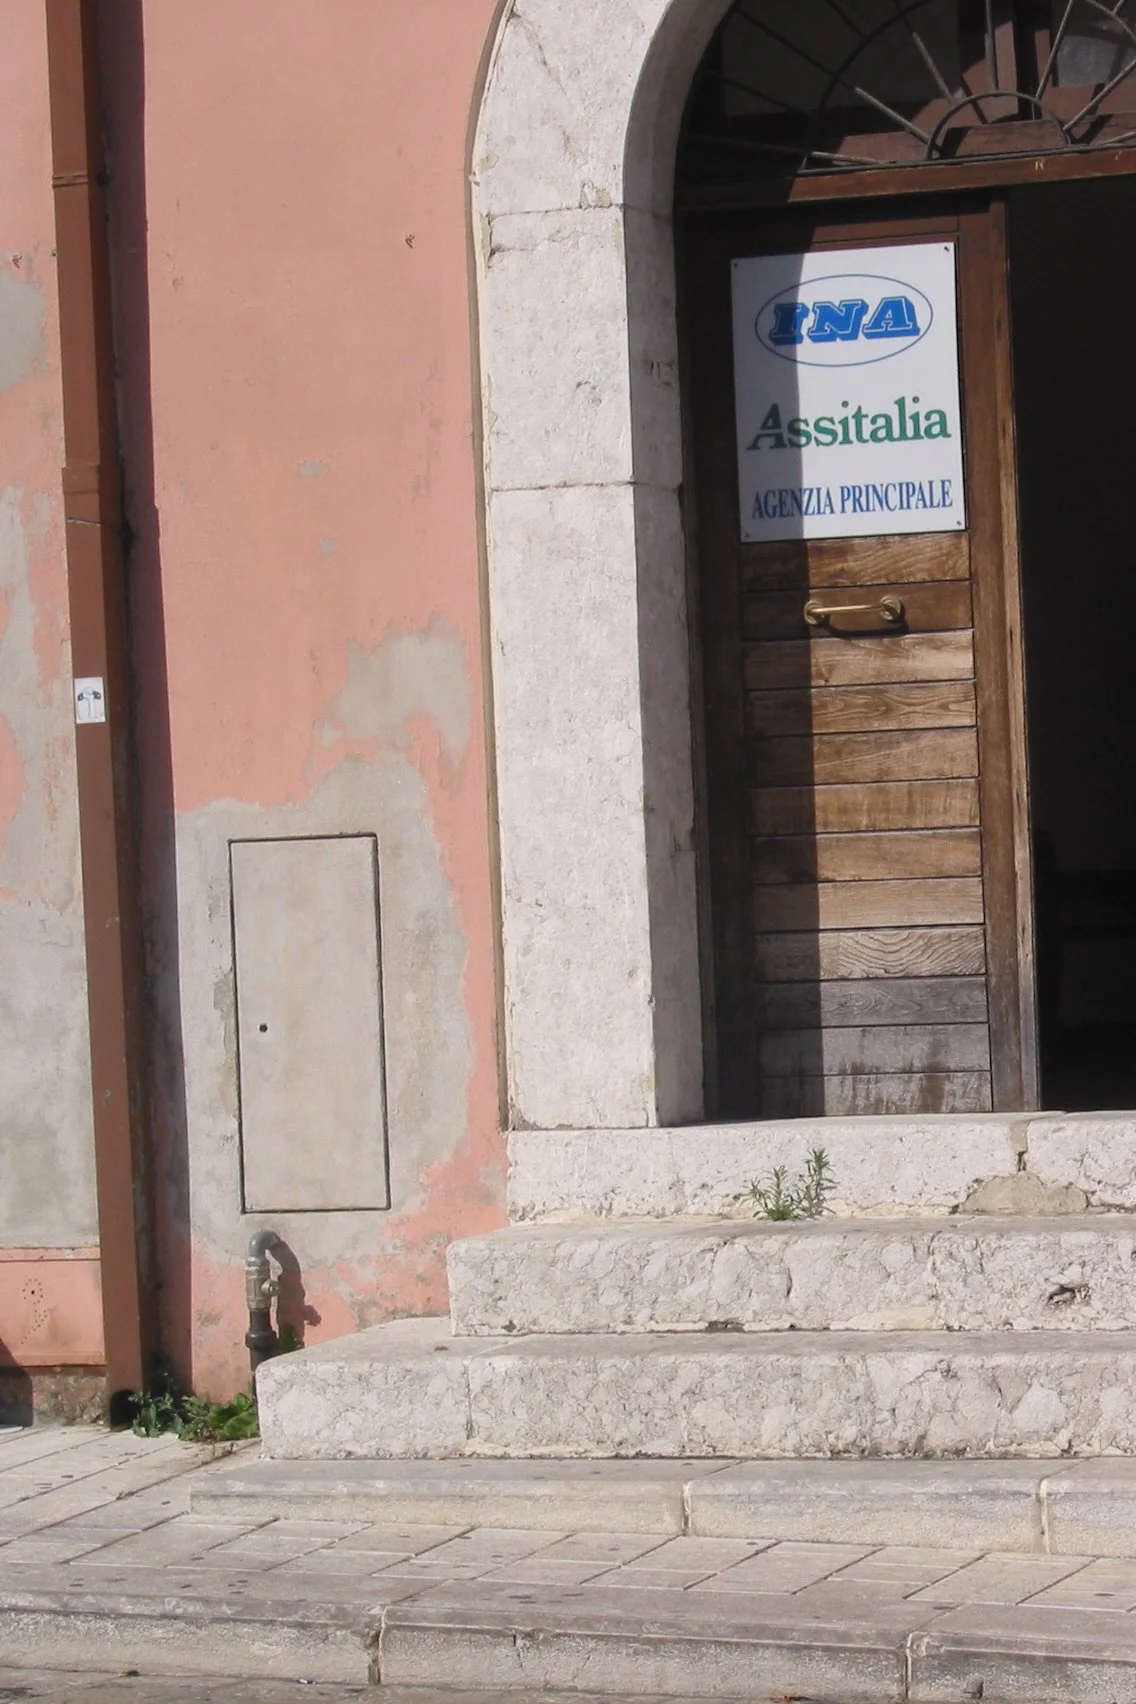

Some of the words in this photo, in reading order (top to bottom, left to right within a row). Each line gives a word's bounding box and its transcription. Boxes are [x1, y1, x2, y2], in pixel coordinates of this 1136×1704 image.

[768, 296, 920, 346] INA
[746, 396, 952, 450] Assitalia
[752, 487, 835, 519] AGENZIA
[840, 479, 953, 514] PRINCIPALE
